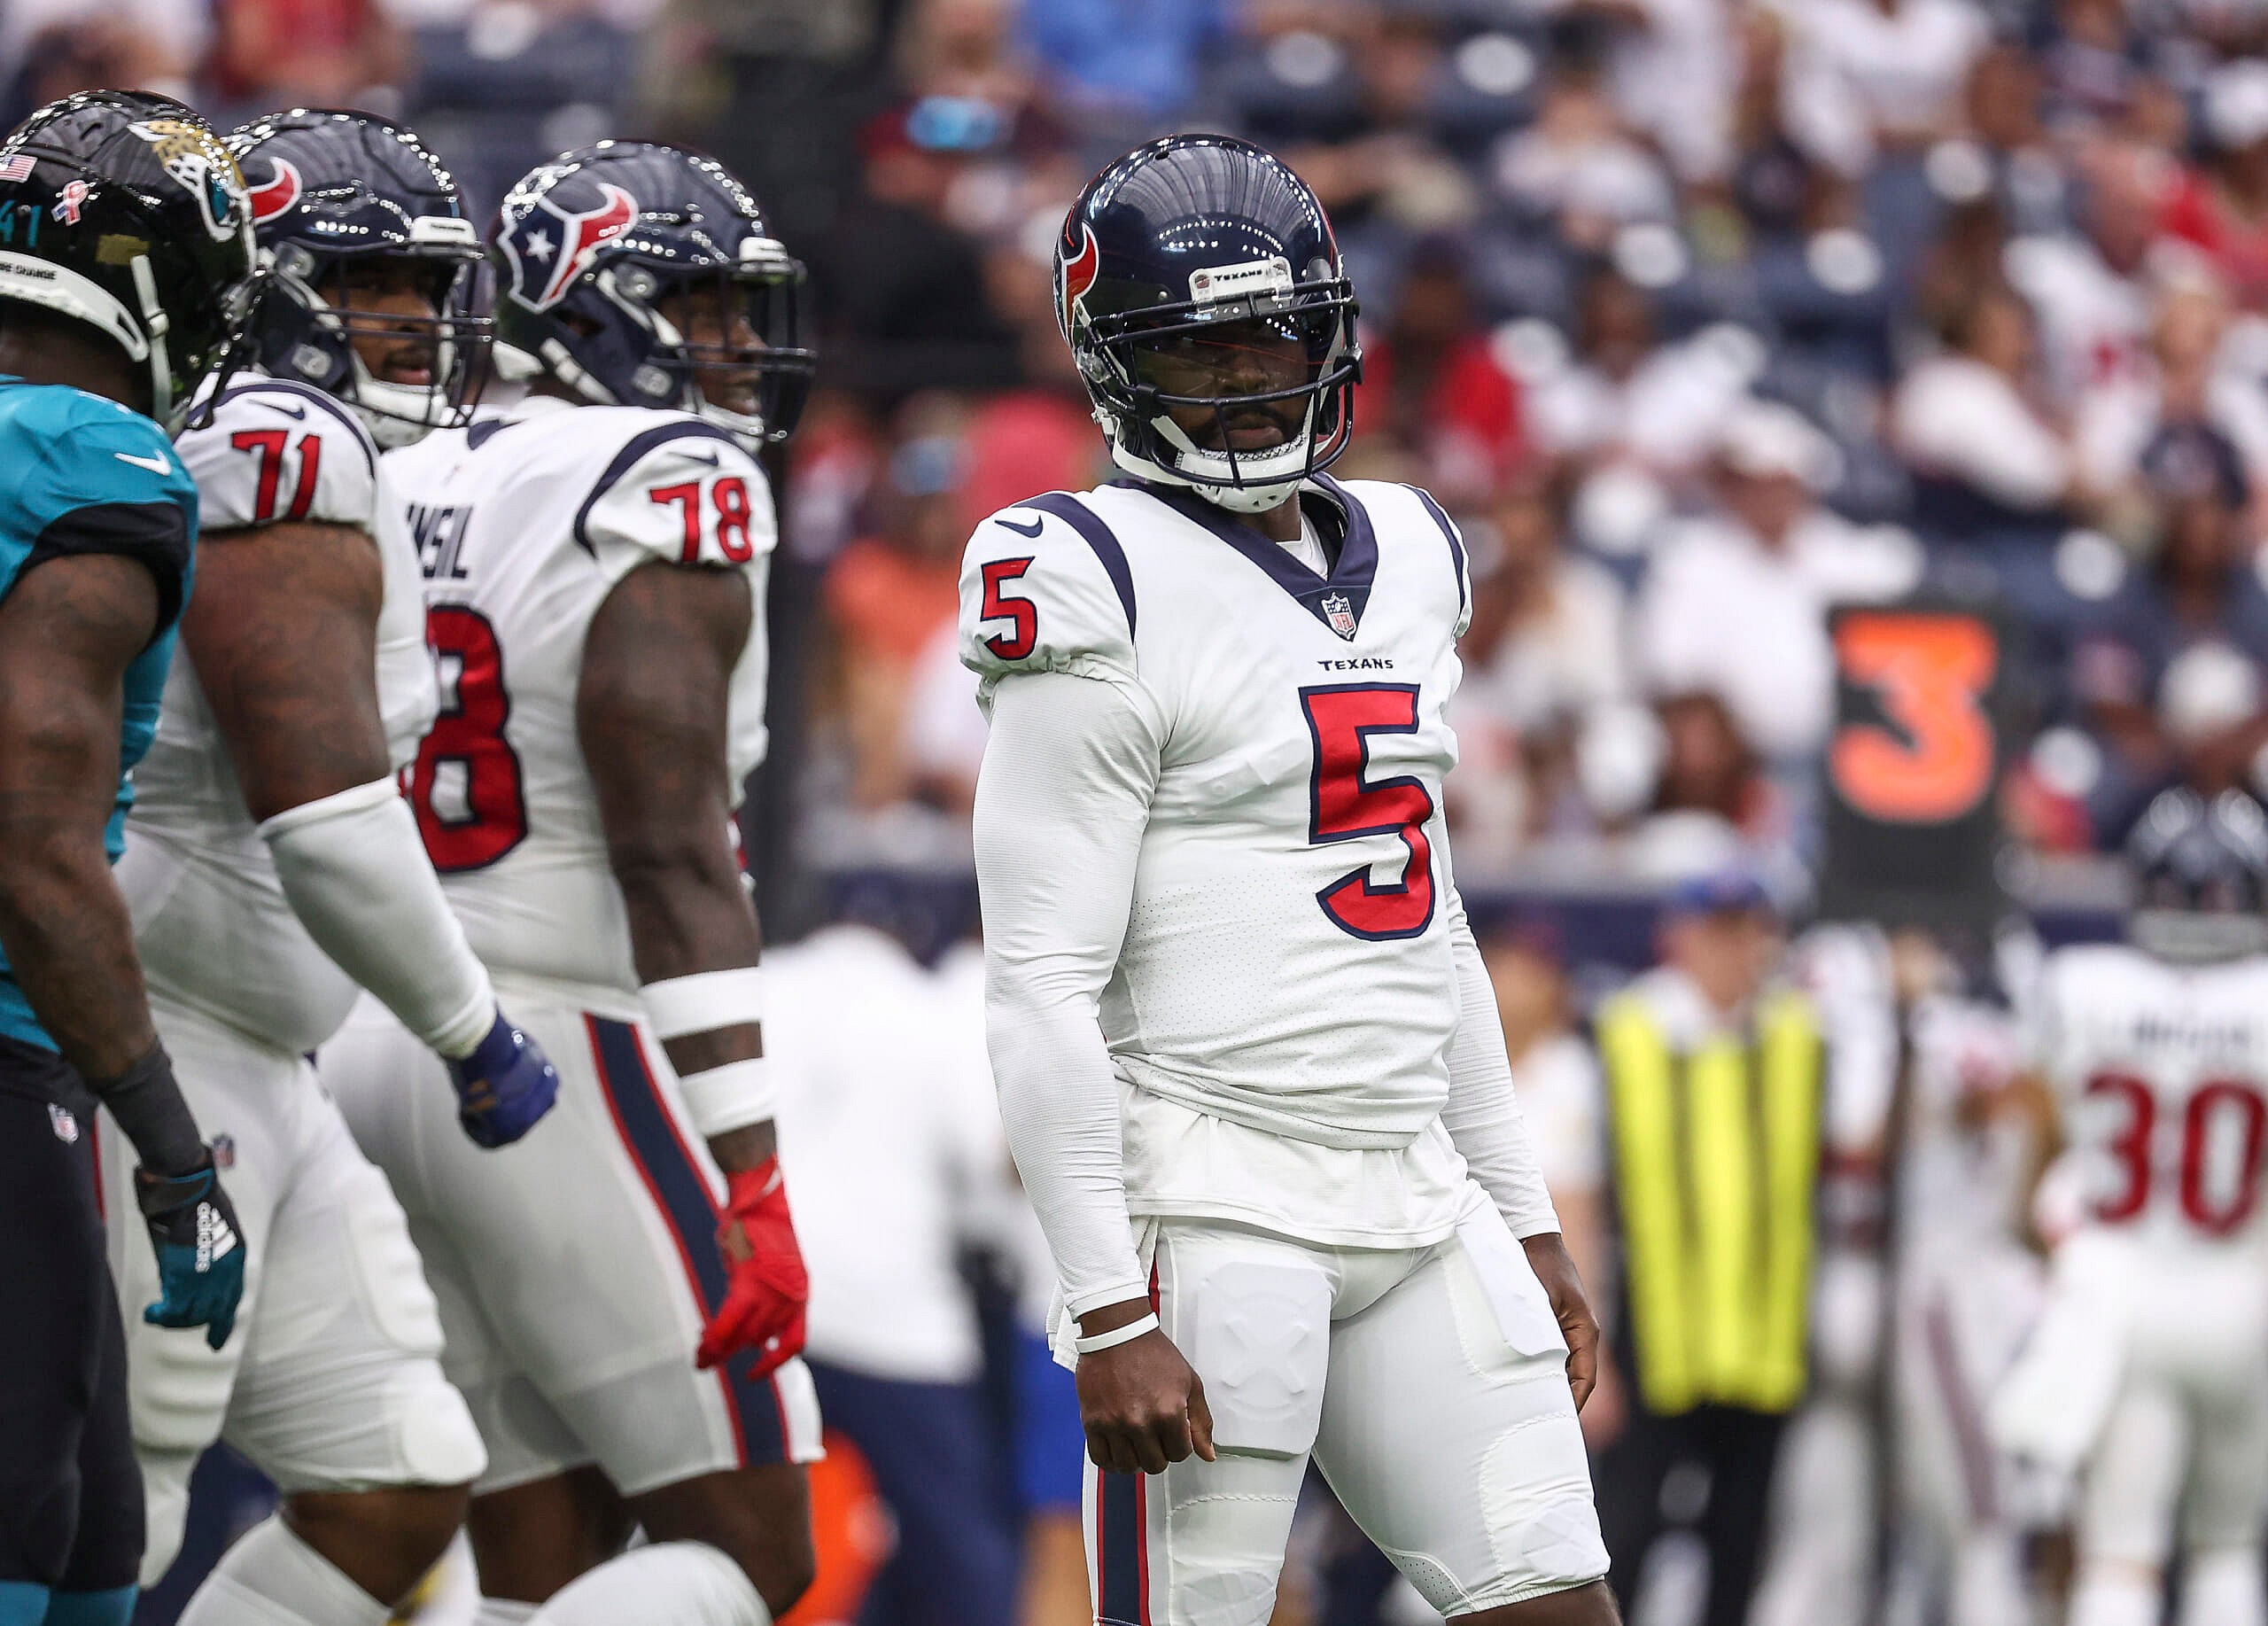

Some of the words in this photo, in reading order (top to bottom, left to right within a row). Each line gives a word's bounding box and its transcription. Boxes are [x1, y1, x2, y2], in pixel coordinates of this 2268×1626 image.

[0, 199, 43, 247] 41
[1214, 268, 1262, 282] TEXANS
[230, 429, 321, 521] 71
[649, 477, 752, 563] 78
[981, 556, 1037, 660] 5
[1317, 658, 1394, 671] TEXANS
[399, 605, 528, 874] 8
[1829, 608, 1997, 822] 3
[1298, 681, 1435, 942] 5
[2084, 1070, 2266, 1236] 30
[195, 1202, 213, 1273] adidas
